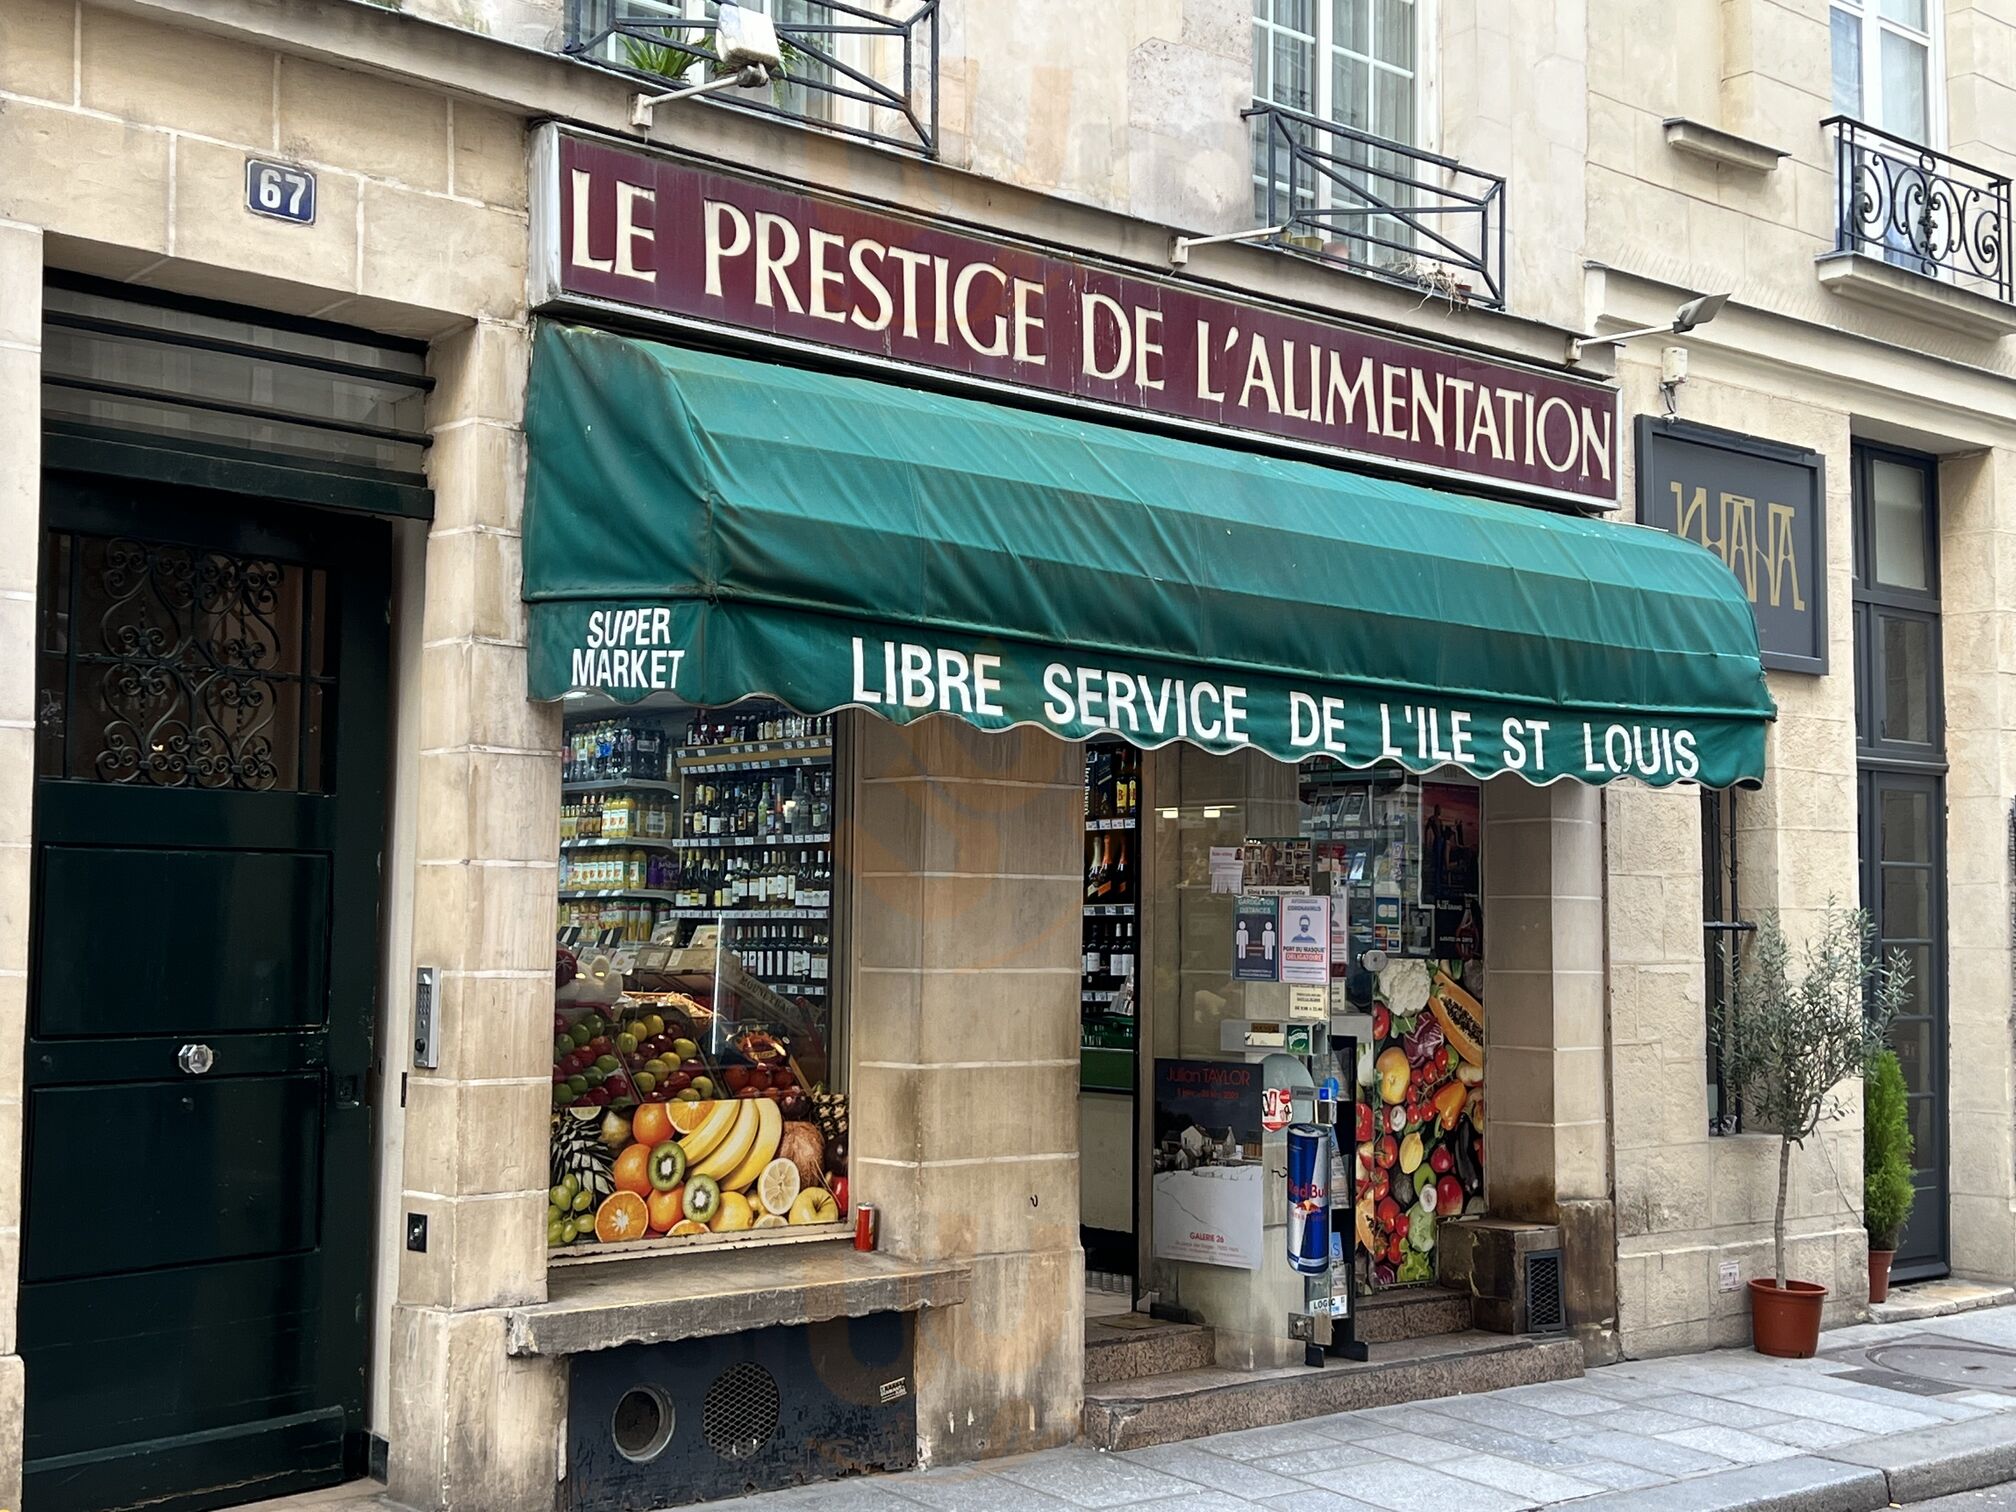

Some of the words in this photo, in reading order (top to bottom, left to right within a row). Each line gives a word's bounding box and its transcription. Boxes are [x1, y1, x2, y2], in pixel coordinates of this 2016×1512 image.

[259, 168, 306, 215] 67
[570, 168, 656, 283] LE
[703, 198, 1046, 366] PRESTIGE
[1080, 292, 1165, 391] DE
[1197, 319, 1612, 481] L'ALIMENTATION
[586, 607, 671, 648] SUPER
[570, 648, 685, 689] MARKET
[851, 636, 1004, 717] LIBRE
[1043, 662, 1249, 743] SERVICE
[1289, 691, 1346, 753] DE
[1379, 703, 1476, 764] L'ILE
[1502, 717, 1551, 771] ST
[1582, 722, 1700, 778] LOUIS
[1282, 945, 1295, 953] PORT
[1167, 1067, 1200, 1083] Julian
[1202, 1068, 1251, 1087] TAYLOR
[1289, 1178, 1310, 1198] Red
[1189, 1232, 1214, 1242] GALERIE
[1216, 1235, 1225, 1243] 26
